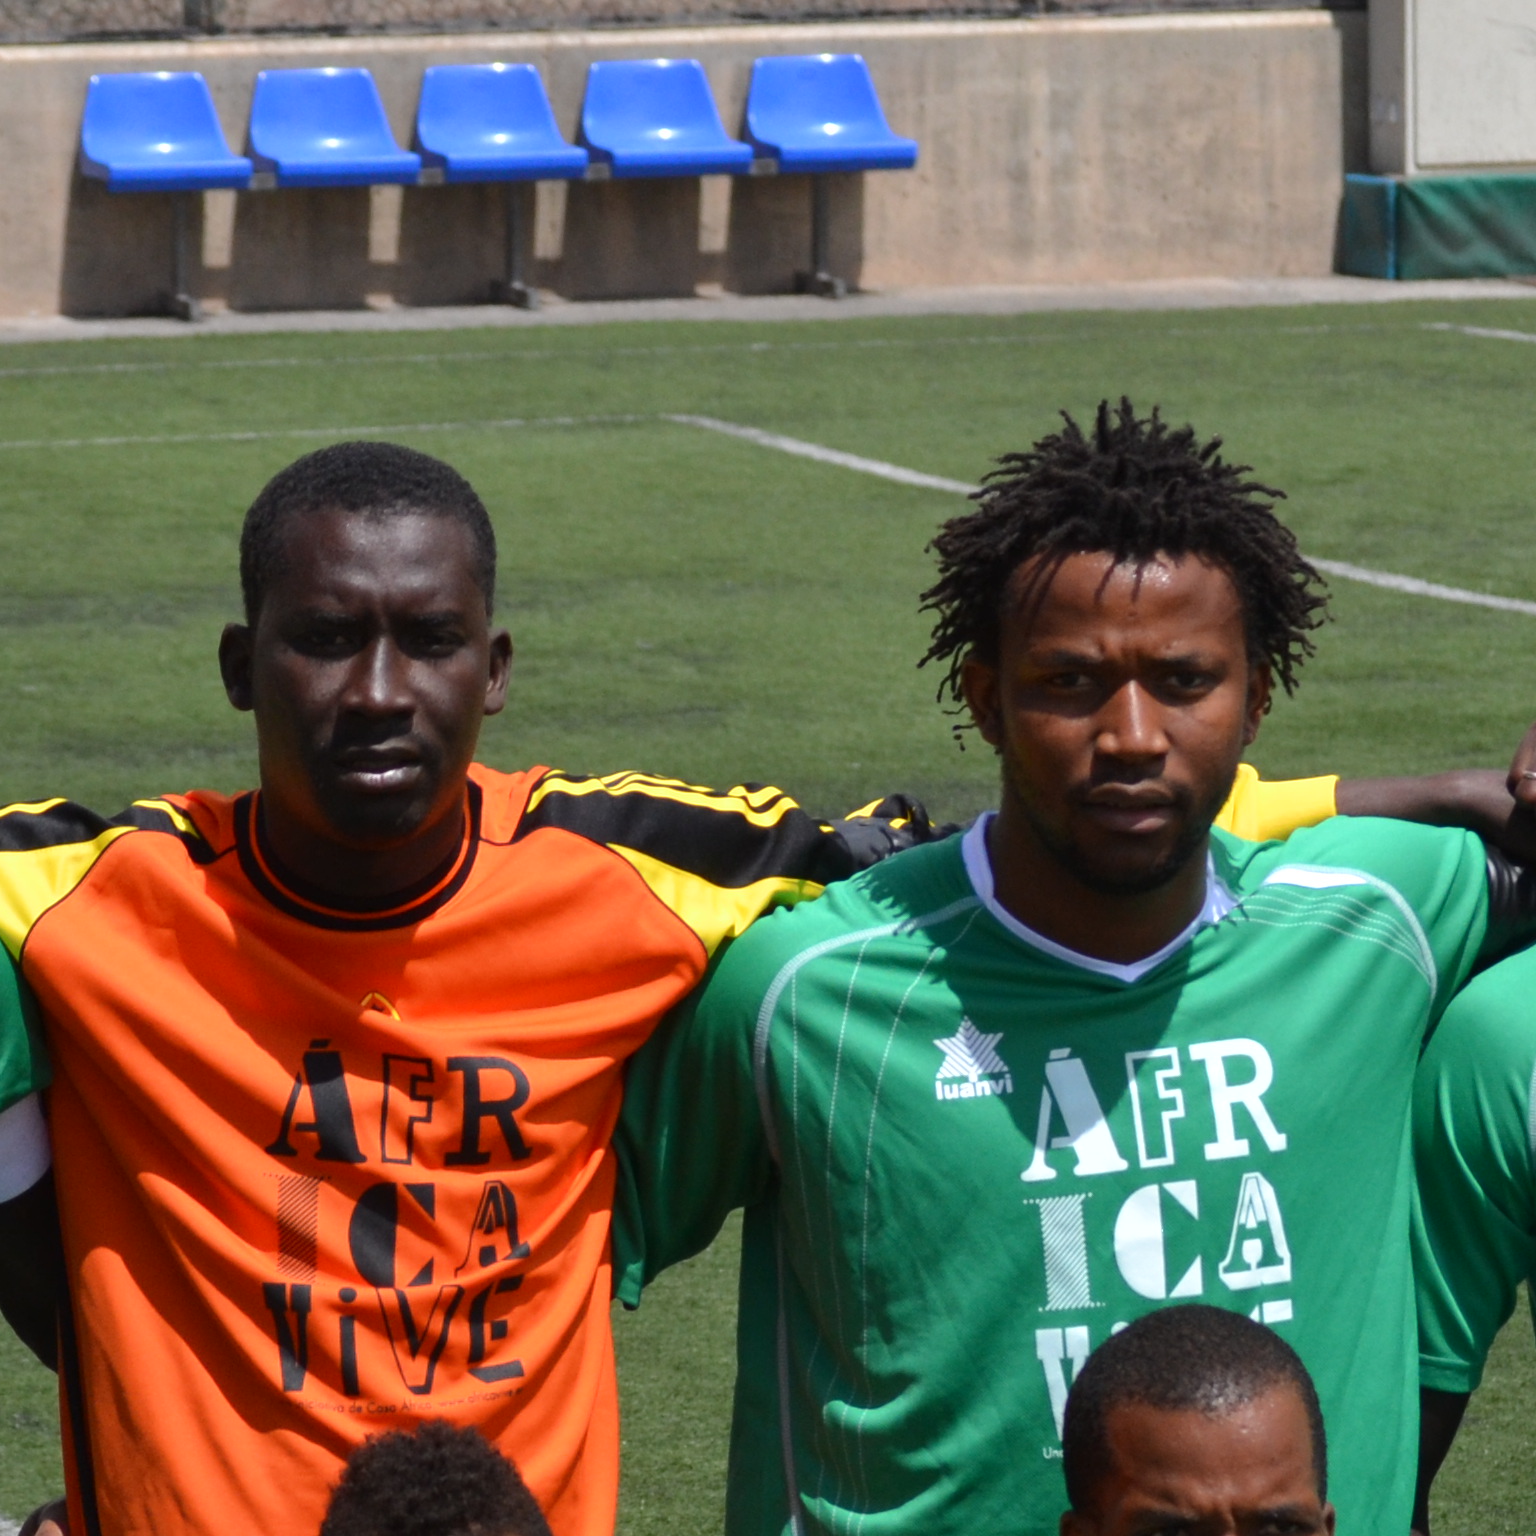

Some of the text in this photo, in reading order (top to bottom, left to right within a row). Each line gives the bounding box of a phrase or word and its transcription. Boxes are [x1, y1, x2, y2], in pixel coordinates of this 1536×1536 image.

[266, 1039, 532, 1167] ÁFR
[935, 1074, 1012, 1100] luanvi
[1020, 1037, 1287, 1182] ÁFR
[263, 1172, 532, 1288] ICA
[1023, 1171, 1291, 1312] ICA
